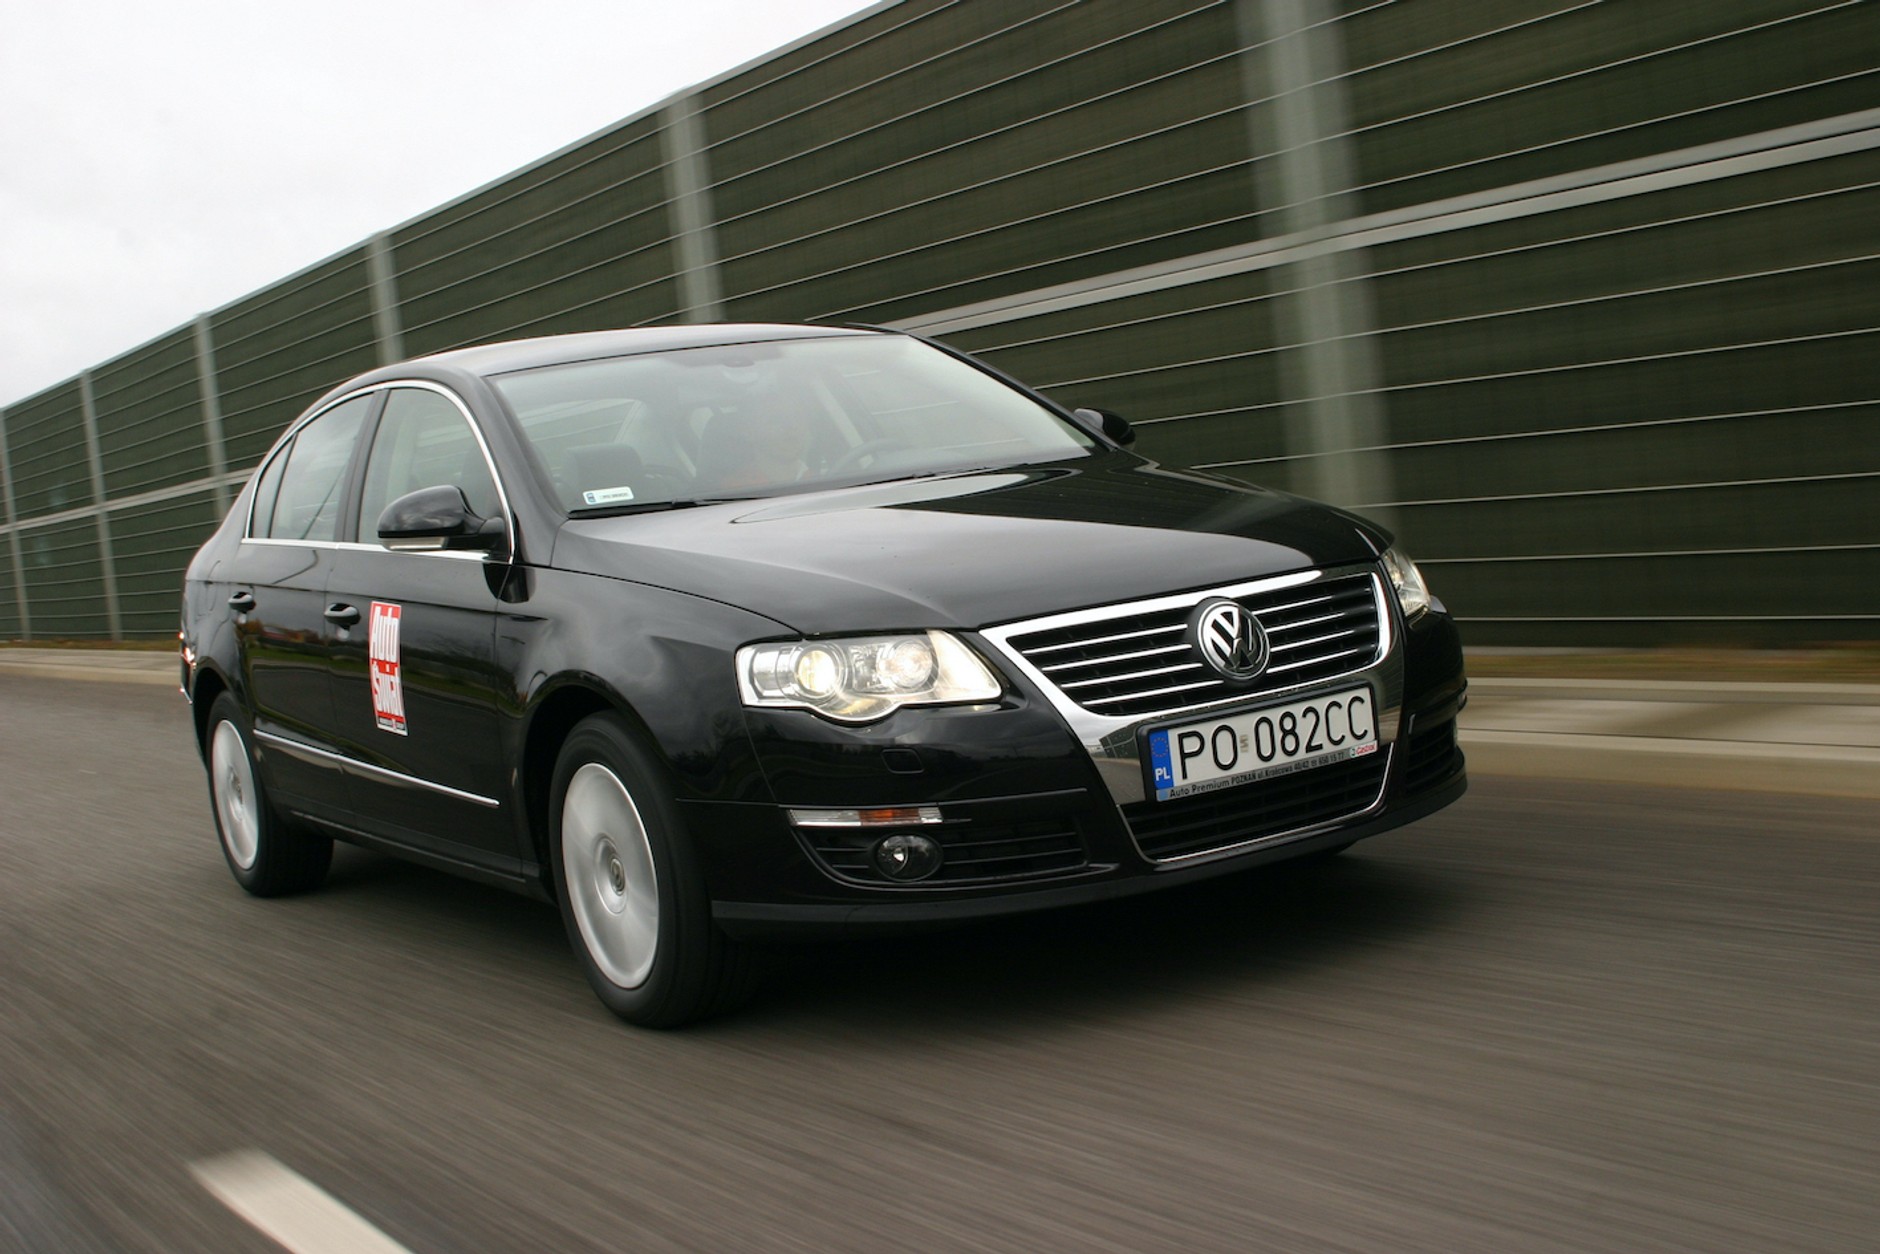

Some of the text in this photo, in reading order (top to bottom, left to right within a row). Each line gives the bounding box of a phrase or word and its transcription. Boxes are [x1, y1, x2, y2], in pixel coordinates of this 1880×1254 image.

[370, 605, 399, 663] Auto
[1178, 696, 1368, 779] PO 082CC
[1155, 767, 1170, 781] PL
[1170, 788, 1190, 798] Auto
[1192, 779, 1230, 792] Premium
